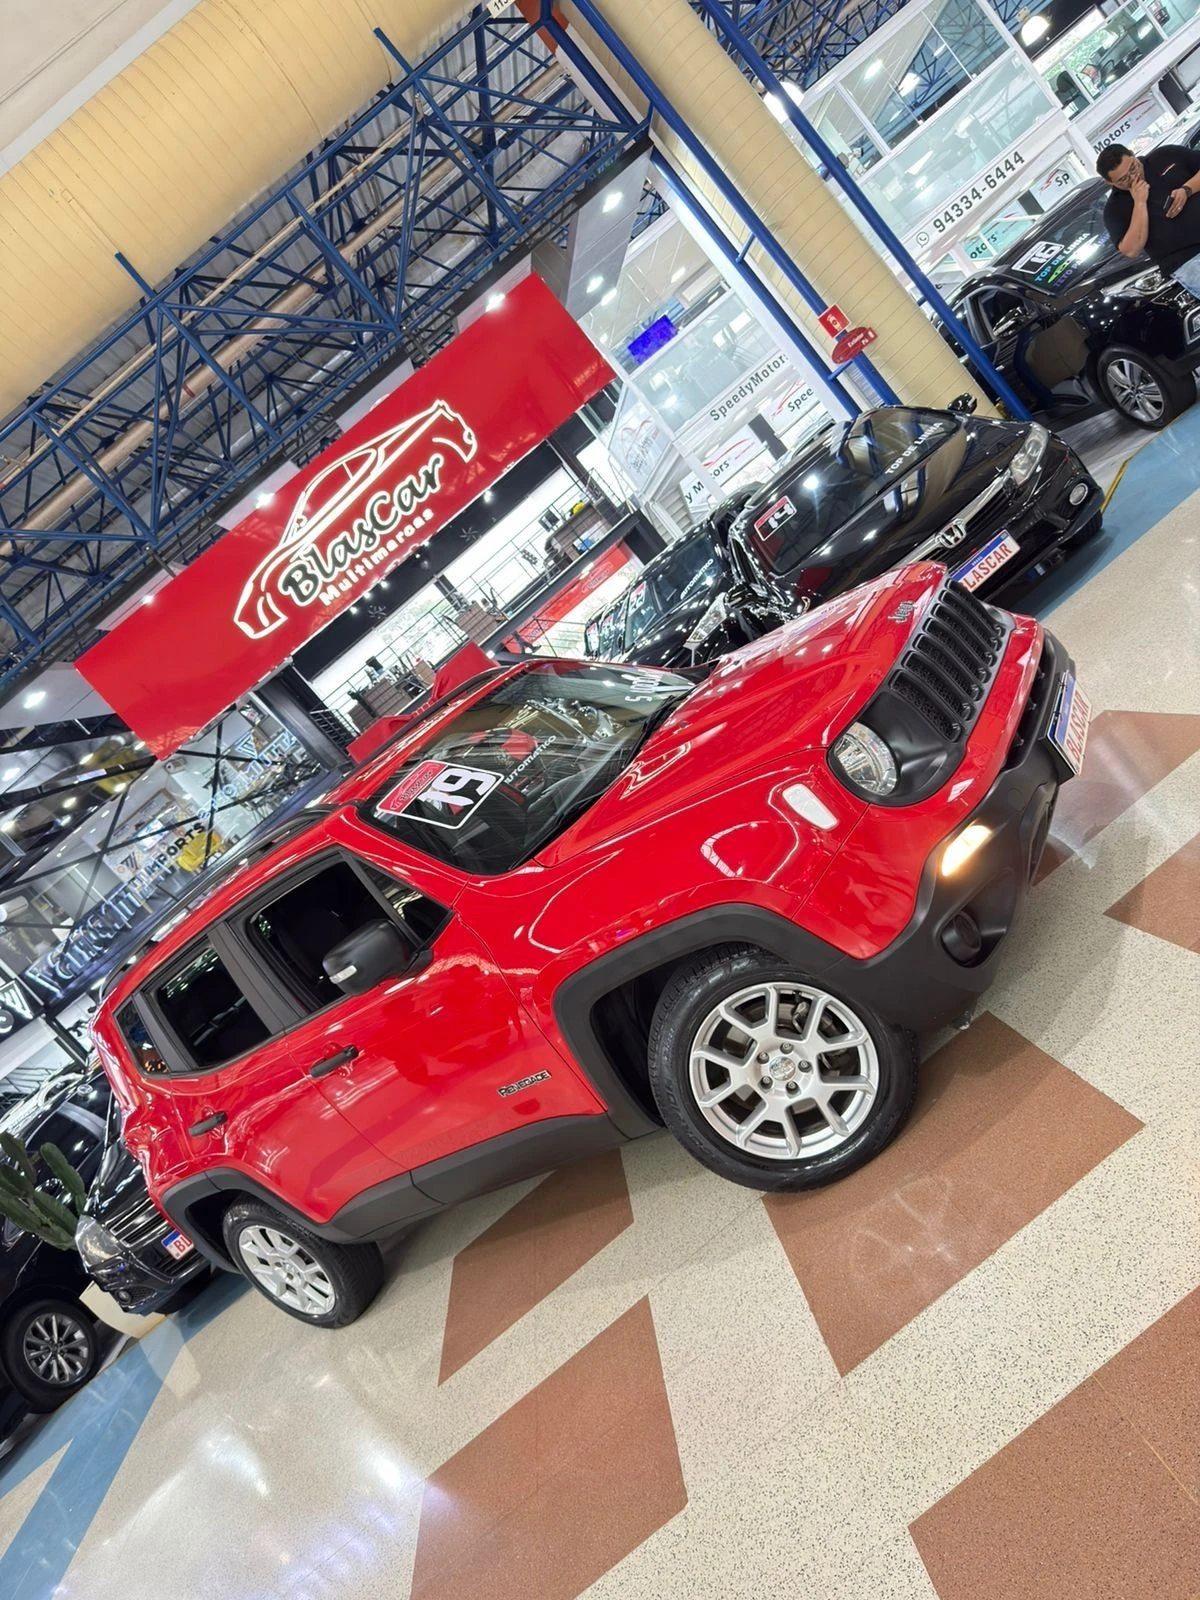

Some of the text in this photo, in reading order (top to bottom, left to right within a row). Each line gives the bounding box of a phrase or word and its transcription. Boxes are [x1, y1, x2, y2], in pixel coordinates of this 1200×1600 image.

[1093, 119, 1132, 154] Motors
[932, 151, 1026, 234] 94334-6444
[969, 232, 998, 260] otors
[1034, 265, 1053, 283] TOP
[710, 353, 790, 421] SpeedyMotor
[884, 422, 944, 475] TOP DE LINHA
[278, 452, 444, 607] BlasCar
[768, 503, 795, 529] 14
[961, 543, 1013, 589] LASCAR
[1065, 689, 1090, 763] BLASCAR
[417, 768, 497, 807] 19
[497, 1070, 552, 1098] RENEGADE
